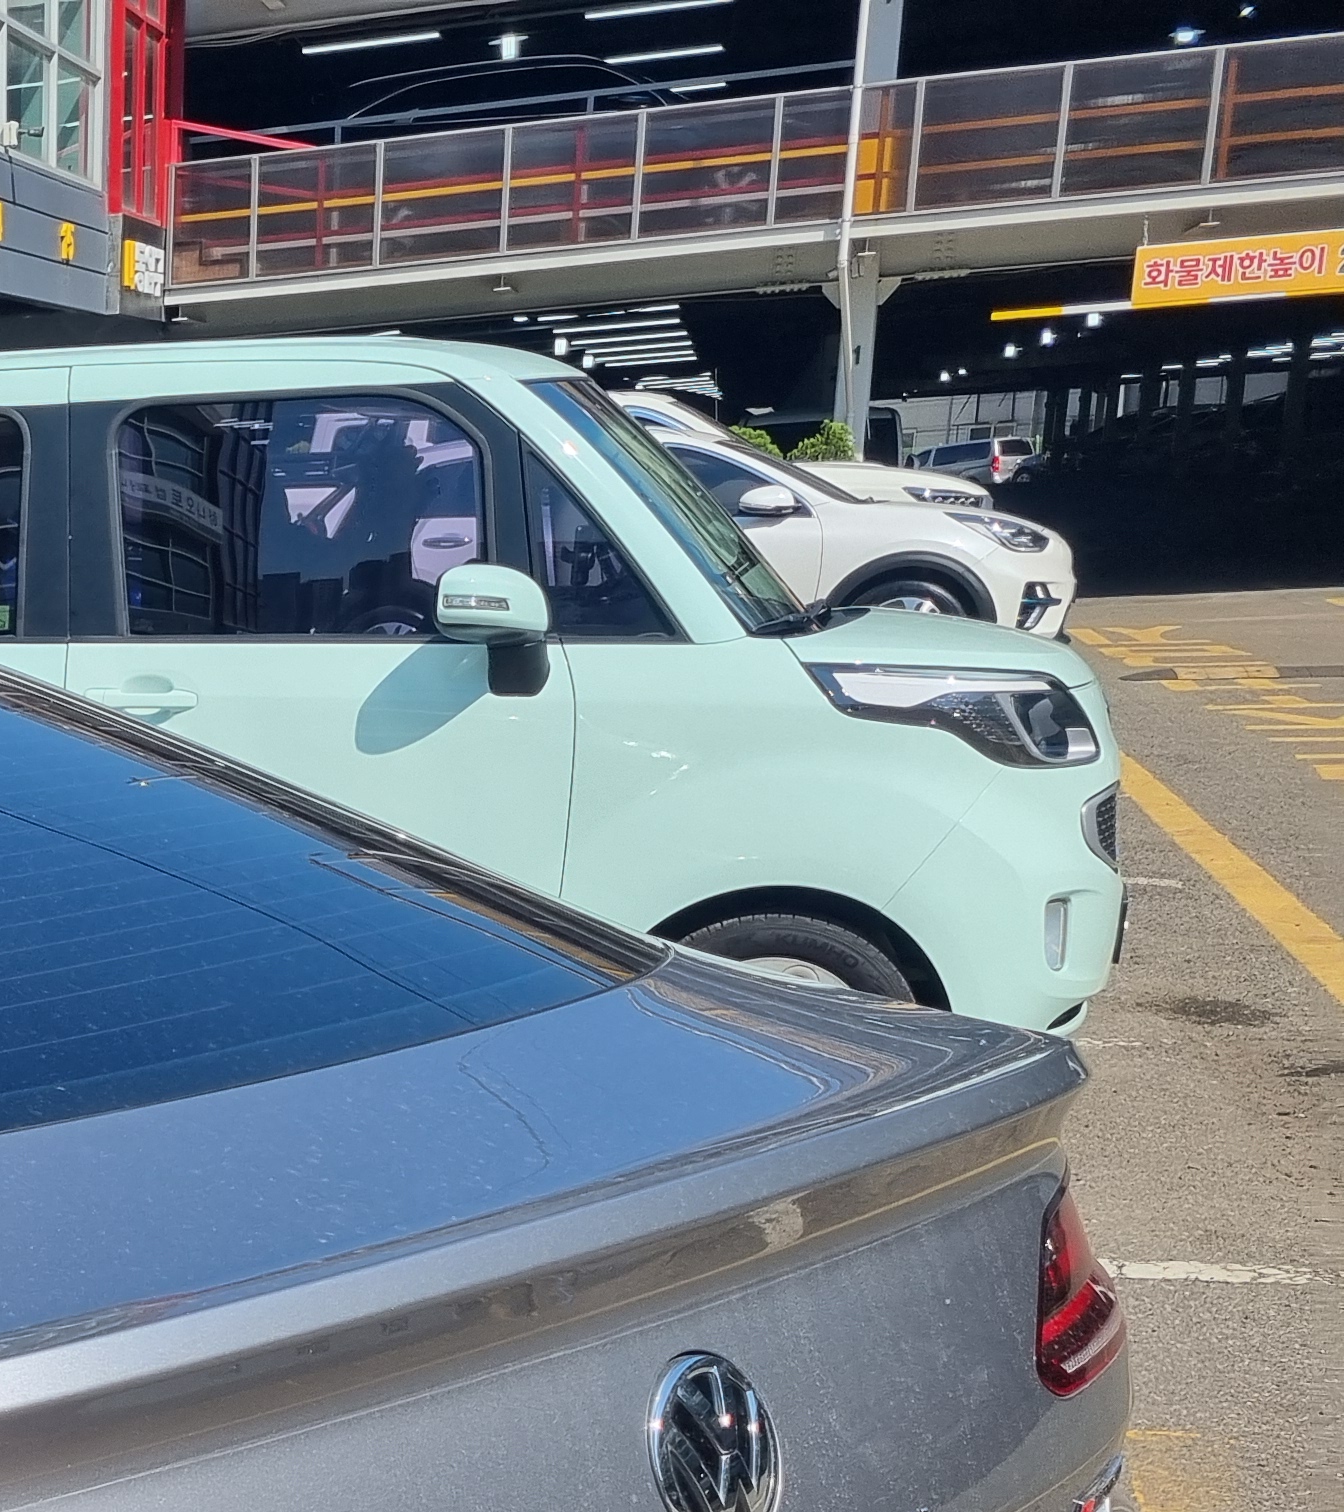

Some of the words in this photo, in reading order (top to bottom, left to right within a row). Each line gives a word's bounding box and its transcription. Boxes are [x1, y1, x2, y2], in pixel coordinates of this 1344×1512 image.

[60, 223, 75, 260] 15
[1143, 245, 1326, 289] 화물제한높이
[854, 345, 861, 365] 1
